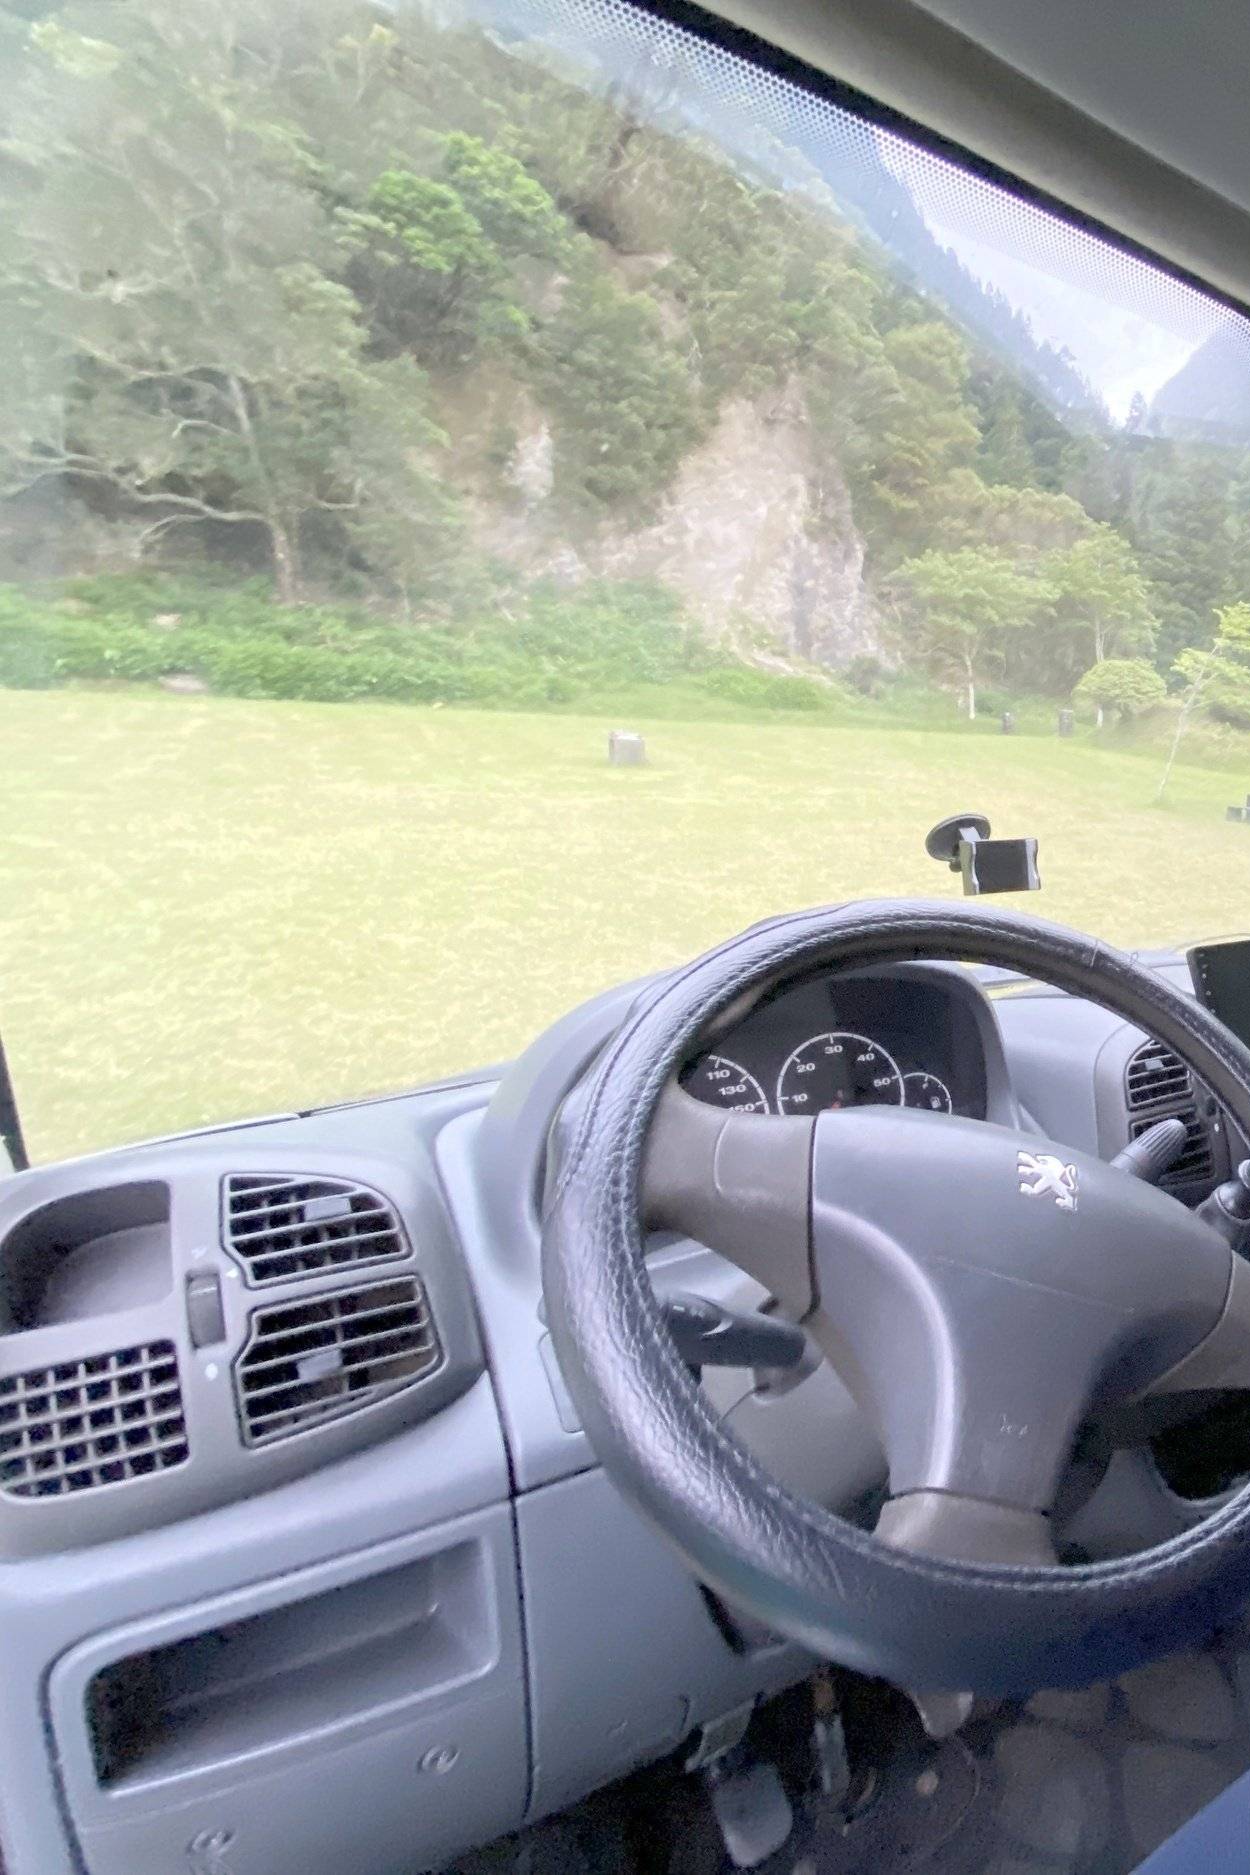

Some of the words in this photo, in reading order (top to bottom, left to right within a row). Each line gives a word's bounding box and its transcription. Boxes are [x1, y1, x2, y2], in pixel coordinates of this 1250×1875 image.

[824, 1045, 843, 1055] 30
[857, 1053, 875, 1062] 40
[796, 1062, 816, 1073] 20
[707, 1069, 731, 1081] 110
[718, 1084, 747, 1096] 130
[791, 1093, 808, 1103] 10
